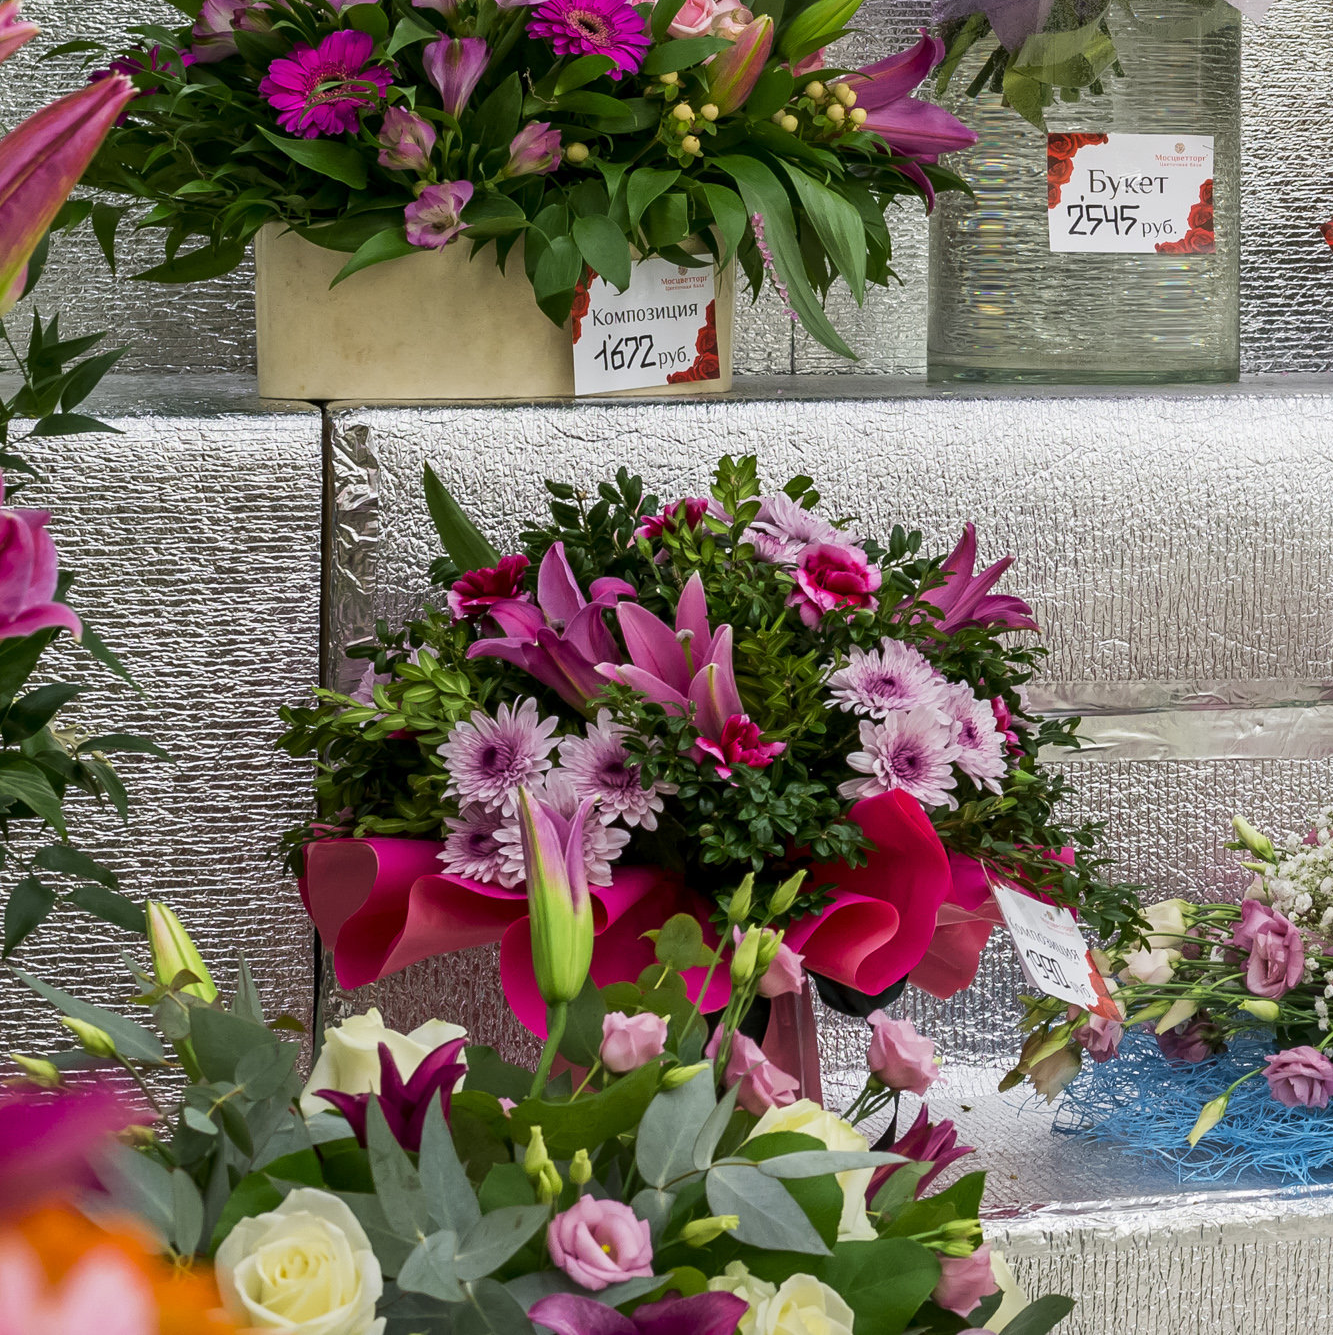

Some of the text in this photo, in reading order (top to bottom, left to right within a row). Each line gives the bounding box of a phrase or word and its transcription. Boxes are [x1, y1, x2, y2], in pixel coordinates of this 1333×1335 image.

[1088, 169, 1169, 199] Букет
[1142, 219, 1177, 237] руб.
[591, 303, 698, 326] Композиция
[658, 346, 691, 369] руб.
[1005, 913, 1080, 962] Композиция
